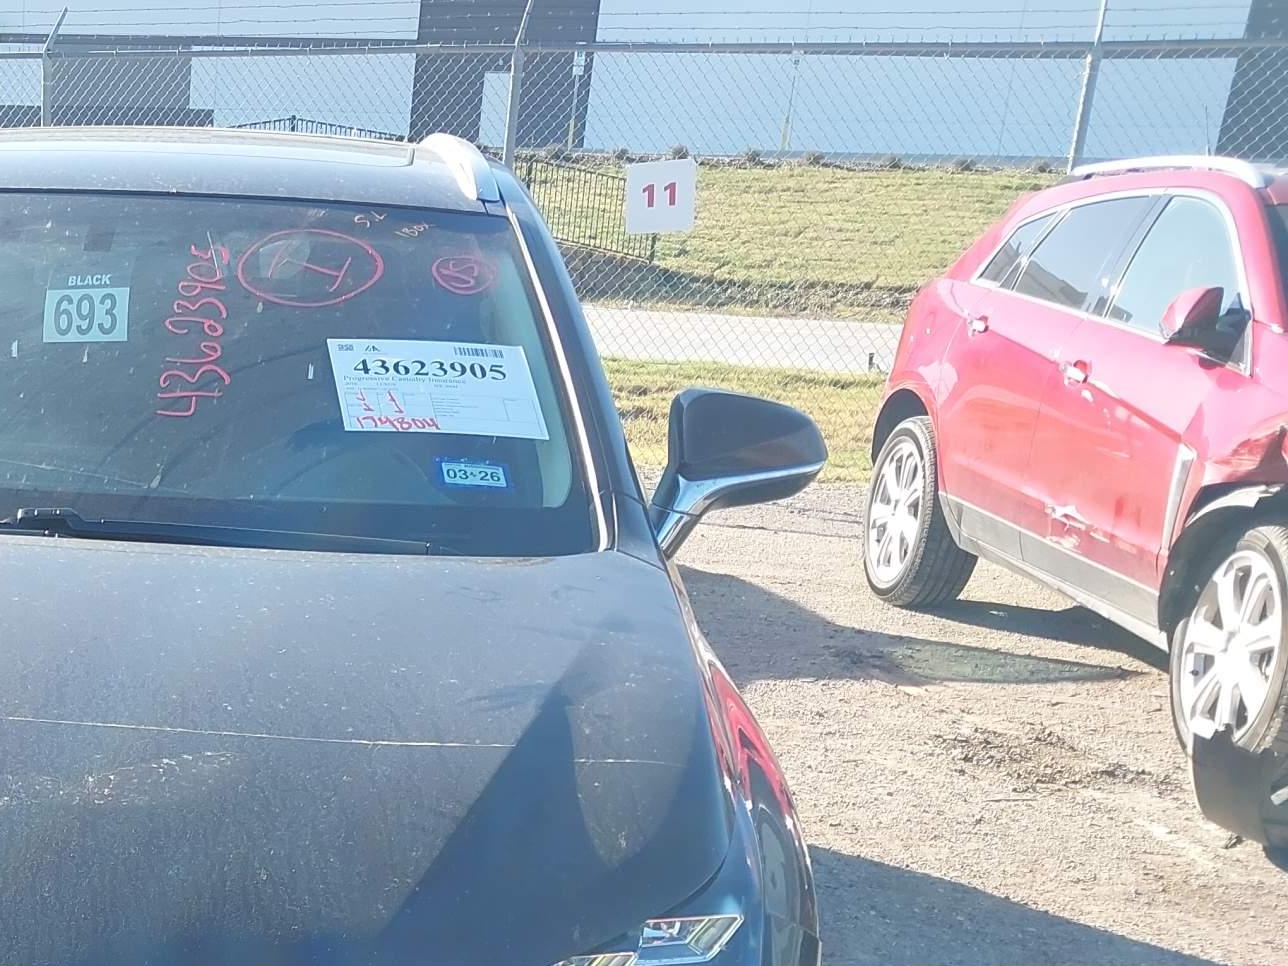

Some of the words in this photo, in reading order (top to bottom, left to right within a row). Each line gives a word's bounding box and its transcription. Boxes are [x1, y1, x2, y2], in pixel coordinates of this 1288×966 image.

[642, 181, 677, 208] 11
[67, 273, 113, 287] BLACK
[53, 292, 118, 336] 693
[156, 243, 231, 417] 43623905
[353, 358, 507, 381] 43623905
